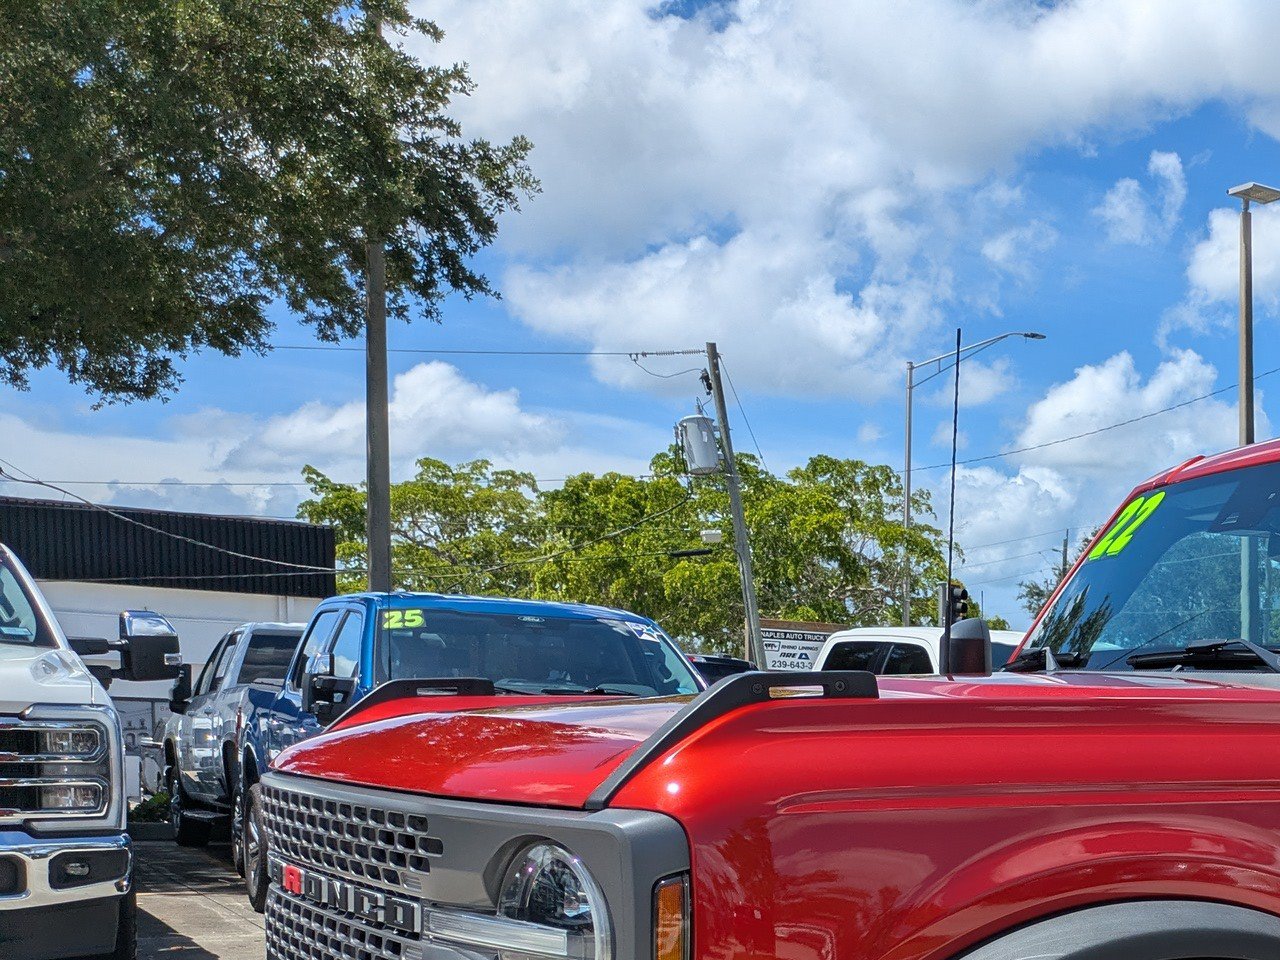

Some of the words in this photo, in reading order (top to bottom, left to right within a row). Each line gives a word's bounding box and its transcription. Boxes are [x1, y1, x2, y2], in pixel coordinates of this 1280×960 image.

[1088, 490, 1166, 561] 22
[383, 609, 424, 628] 25
[761, 631, 784, 639] NAPLES
[772, 660, 813, 669] 239-643-3
[268, 856, 423, 934] BRONCO
